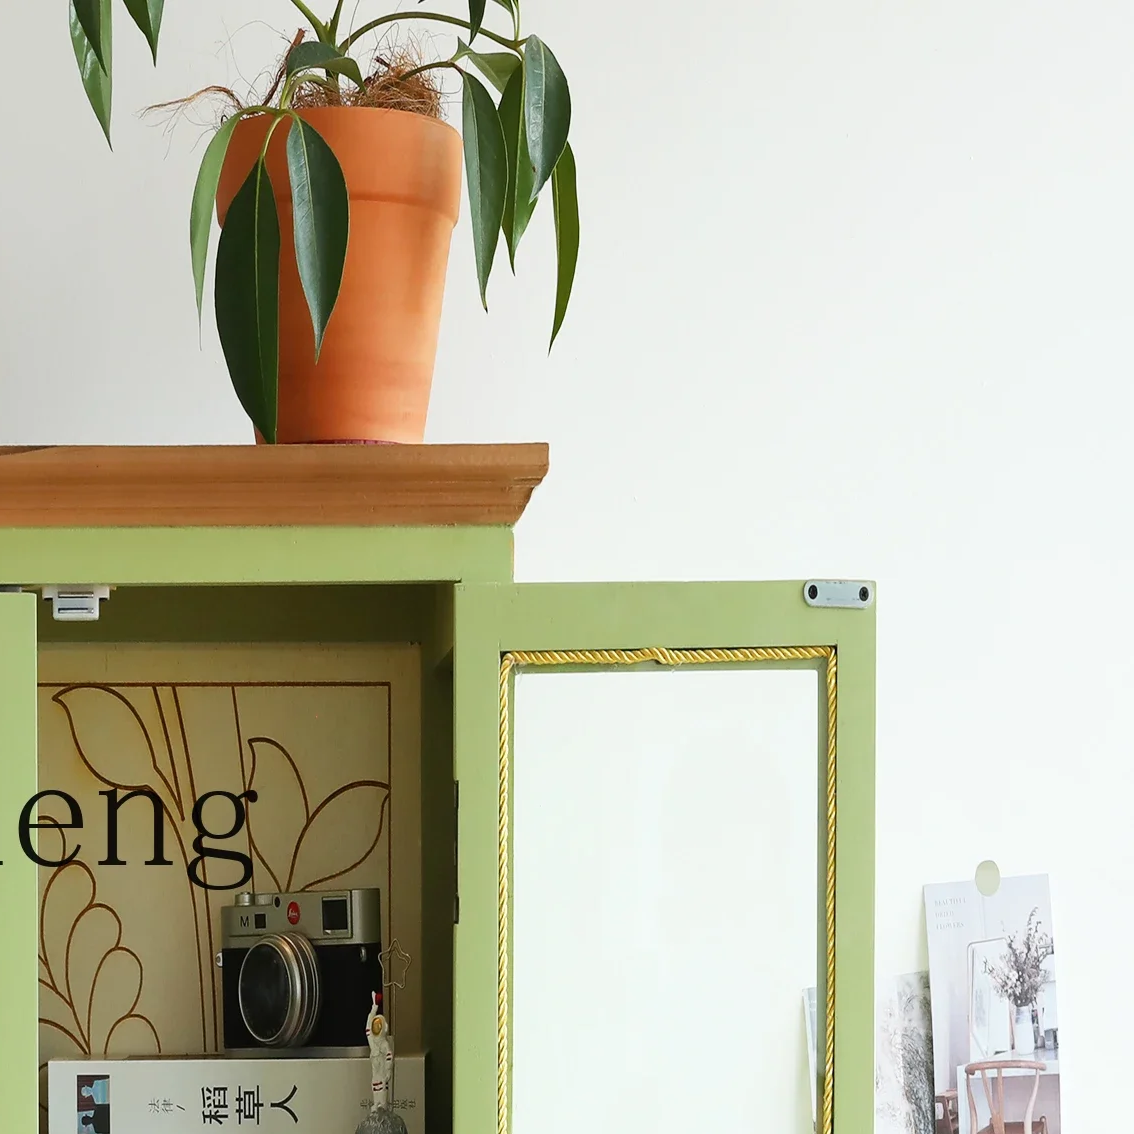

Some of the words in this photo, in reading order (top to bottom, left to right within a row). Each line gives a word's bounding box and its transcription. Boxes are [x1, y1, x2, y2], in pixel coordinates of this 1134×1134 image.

[240, 916, 250, 927] M
[201, 1084, 299, 1126] 稻草人
